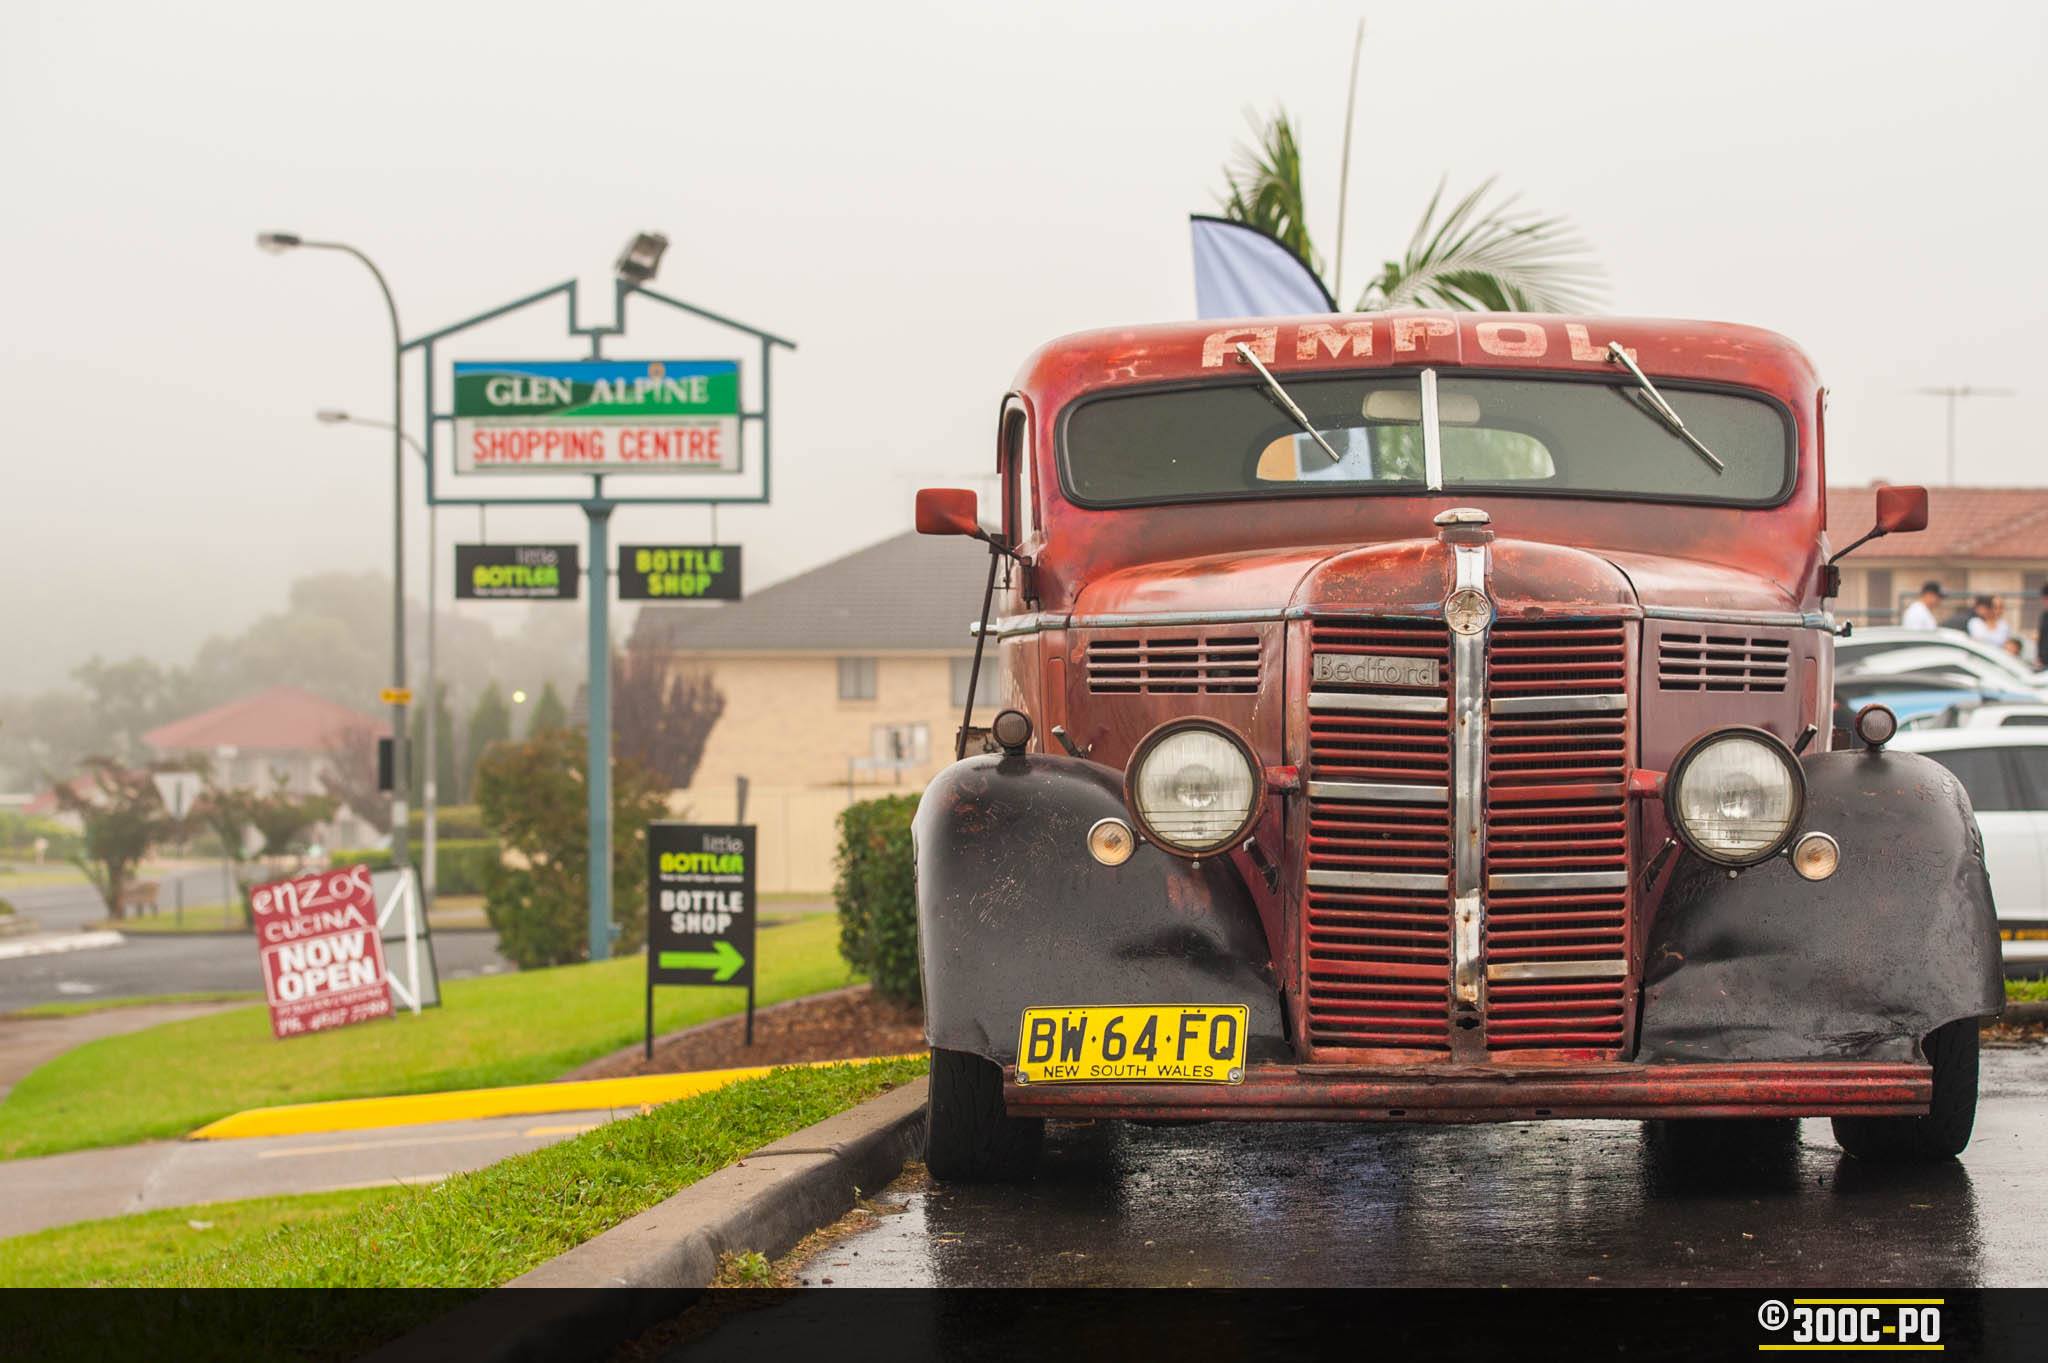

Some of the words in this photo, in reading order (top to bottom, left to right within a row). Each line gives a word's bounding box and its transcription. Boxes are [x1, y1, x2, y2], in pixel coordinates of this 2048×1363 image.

[1202, 318, 1638, 368] AMPOL
[486, 377, 574, 406] GLEN
[590, 375, 709, 405] ALPINE
[473, 429, 604, 463] SHOPPING
[619, 429, 722, 461] CENTRE
[635, 550, 724, 573] BOTTLE
[647, 573, 712, 596] SHOP
[1316, 655, 1438, 686] Bedford
[660, 890, 744, 913] BOTTLE
[264, 903, 370, 942] CUCINA
[671, 912, 732, 934] SHOP
[278, 931, 365, 972] NOW
[277, 956, 377, 1001] OPEN
[1043, 1065, 1080, 1078] NEW
[1090, 1065, 1147, 1077] SOUTH
[1158, 1065, 1214, 1078] WALES
